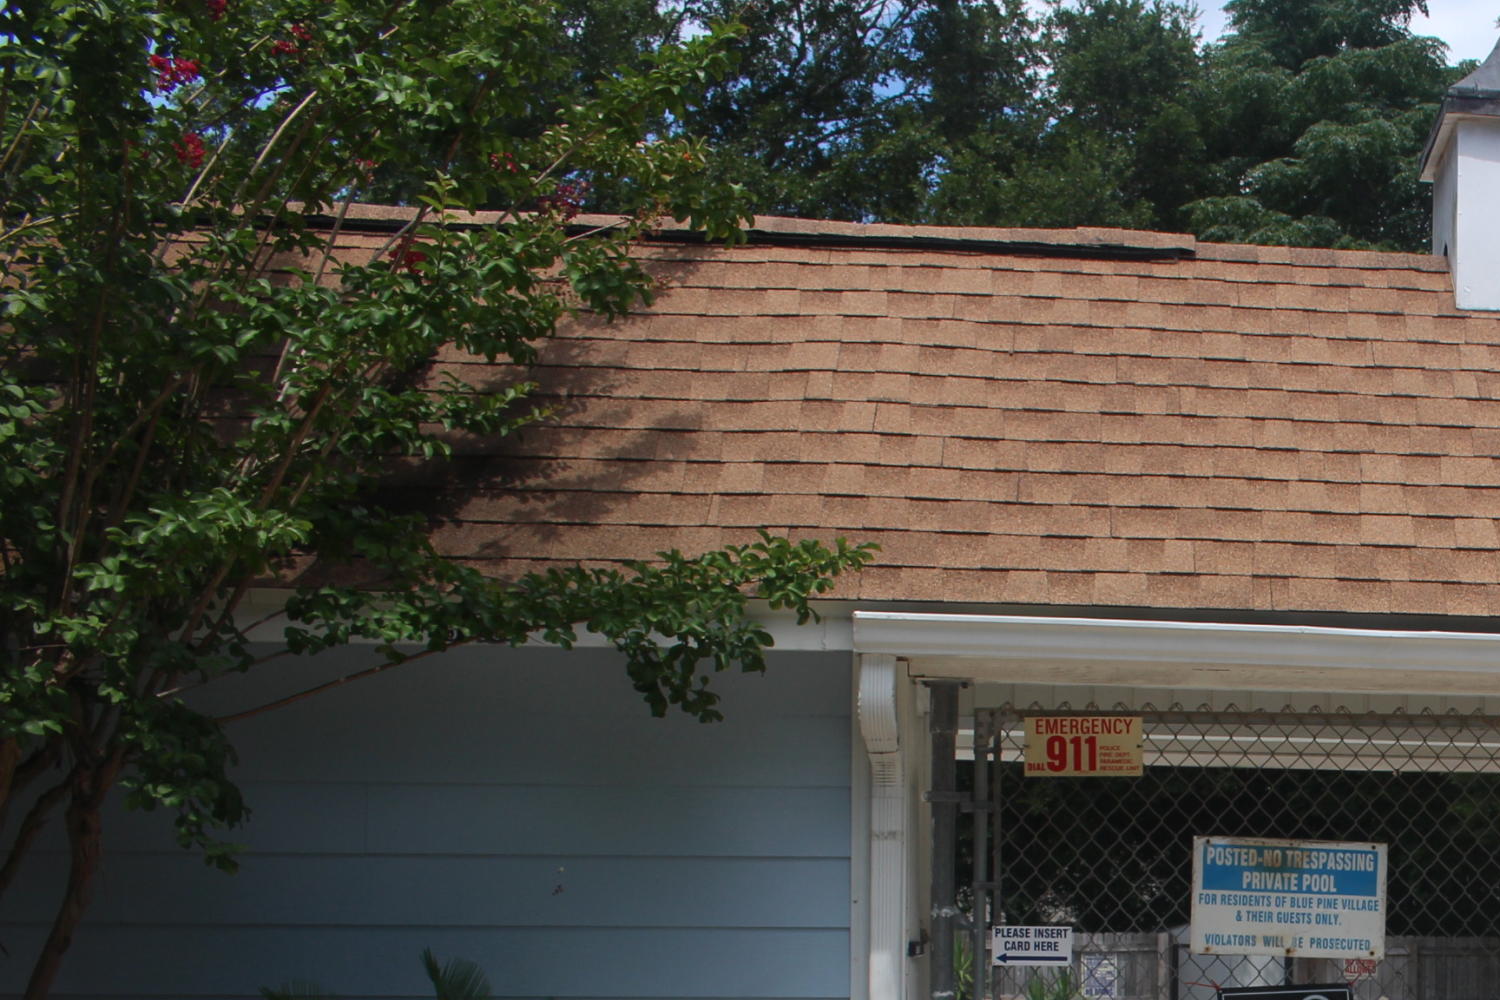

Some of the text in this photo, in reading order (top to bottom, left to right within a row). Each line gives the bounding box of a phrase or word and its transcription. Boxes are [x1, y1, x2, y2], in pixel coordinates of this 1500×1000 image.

[1035, 718, 1133, 734] EMERGENCY
[1028, 735, 1097, 772] DIAL 911
[1285, 850, 1374, 872] TRESPASSING
[1242, 872, 1337, 892] PRIVATE POOL
[1199, 894, 1380, 912] FOR RESIDENTS OF BLUE PINE VILLAGE
[1236, 910, 1342, 926] & THEIR GUESTS ONLY.
[995, 928, 1068, 938] PLEASE INSERT
[1204, 933, 1257, 946] VIOLATORS
[1263, 935, 1284, 948] WILL
[1310, 938, 1371, 951] PROSECUTED
[1004, 941, 1060, 952] CARD HERE
